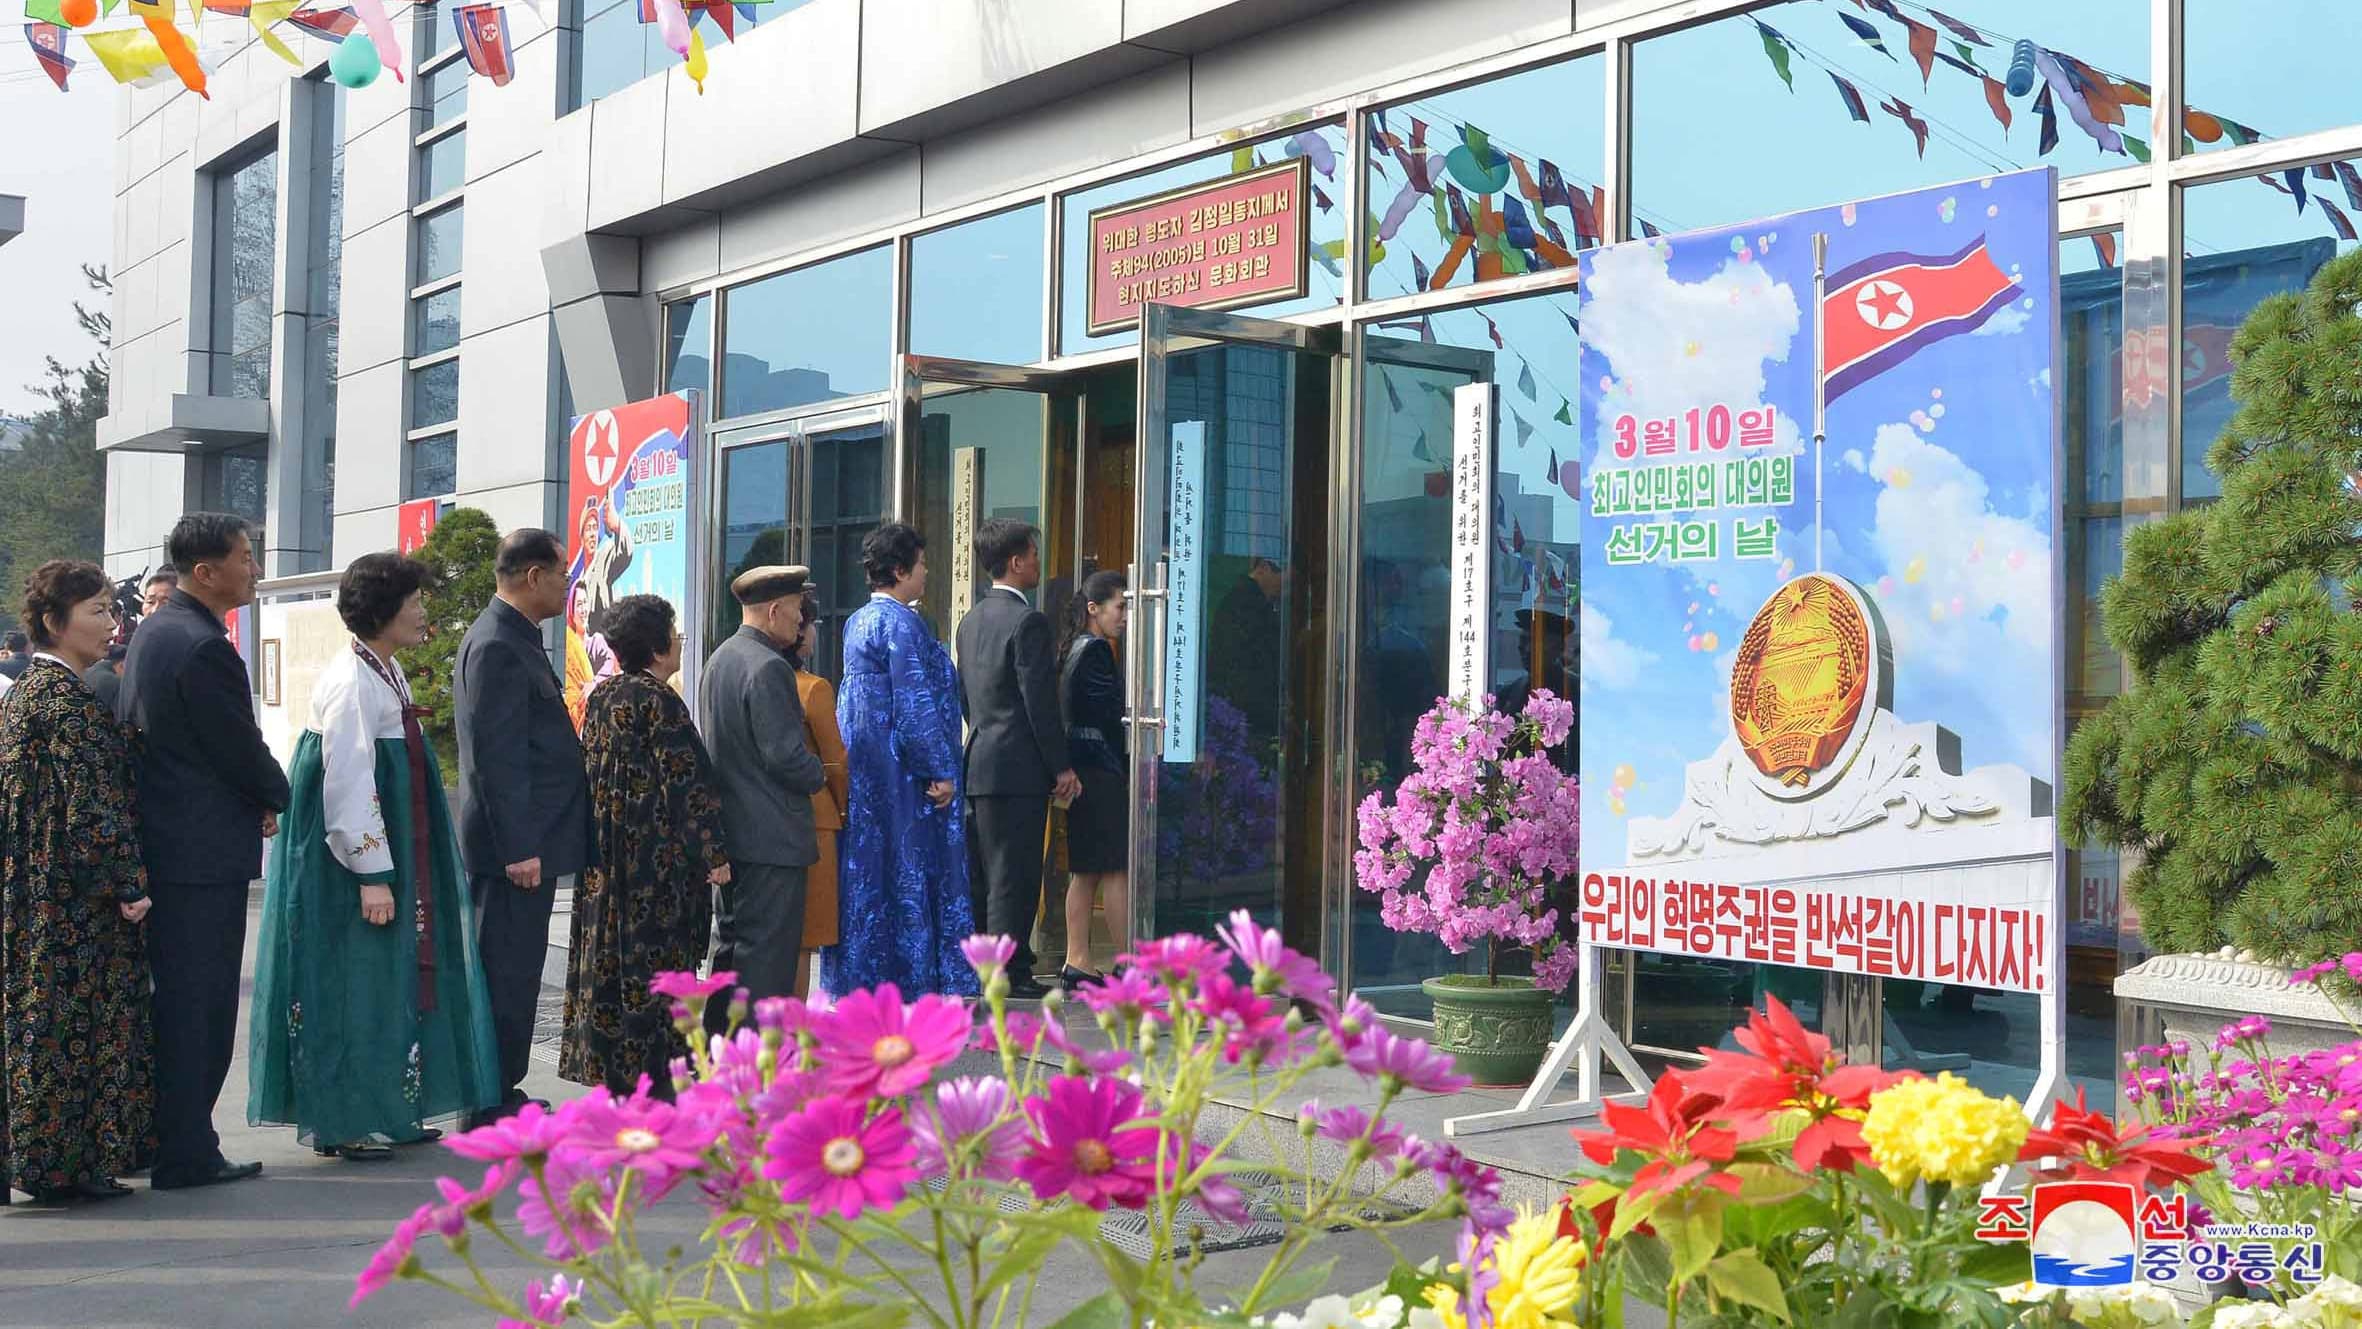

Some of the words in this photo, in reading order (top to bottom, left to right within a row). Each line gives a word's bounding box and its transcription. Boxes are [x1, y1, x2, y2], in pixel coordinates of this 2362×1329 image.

[1102, 226, 1140, 253] 위대한
[1145, 216, 1184, 244] 령도자
[1190, 188, 1290, 234] 김정일동지께서
[1110, 240, 1206, 281] 주체94(2005)년
[1211, 232, 1242, 257] 10월
[1248, 222, 1279, 247] 31일
[1119, 270, 1201, 305] 현지지도하신
[1210, 255, 1270, 287] 문화회관
[1472, 402, 1482, 494] 최고인민회의
[626, 487, 662, 516] 최고인민회의
[664, 482, 683, 510] 대의원
[1458, 454, 1468, 504] 선거를
[1593, 464, 1716, 515] 최고인민회의
[1726, 455, 1793, 506] 대의원
[634, 520, 660, 544] 선거의
[664, 519, 674, 541] 날
[1471, 499, 1480, 546] 대의원
[1607, 522, 1717, 562] 선거의
[1736, 519, 1778, 558] 날
[1582, 872, 1657, 948] 우리의
[1663, 880, 1798, 964] 혁명주권을
[1806, 892, 1925, 979] 반석같이
[1934, 904, 2045, 991] 다지자!
